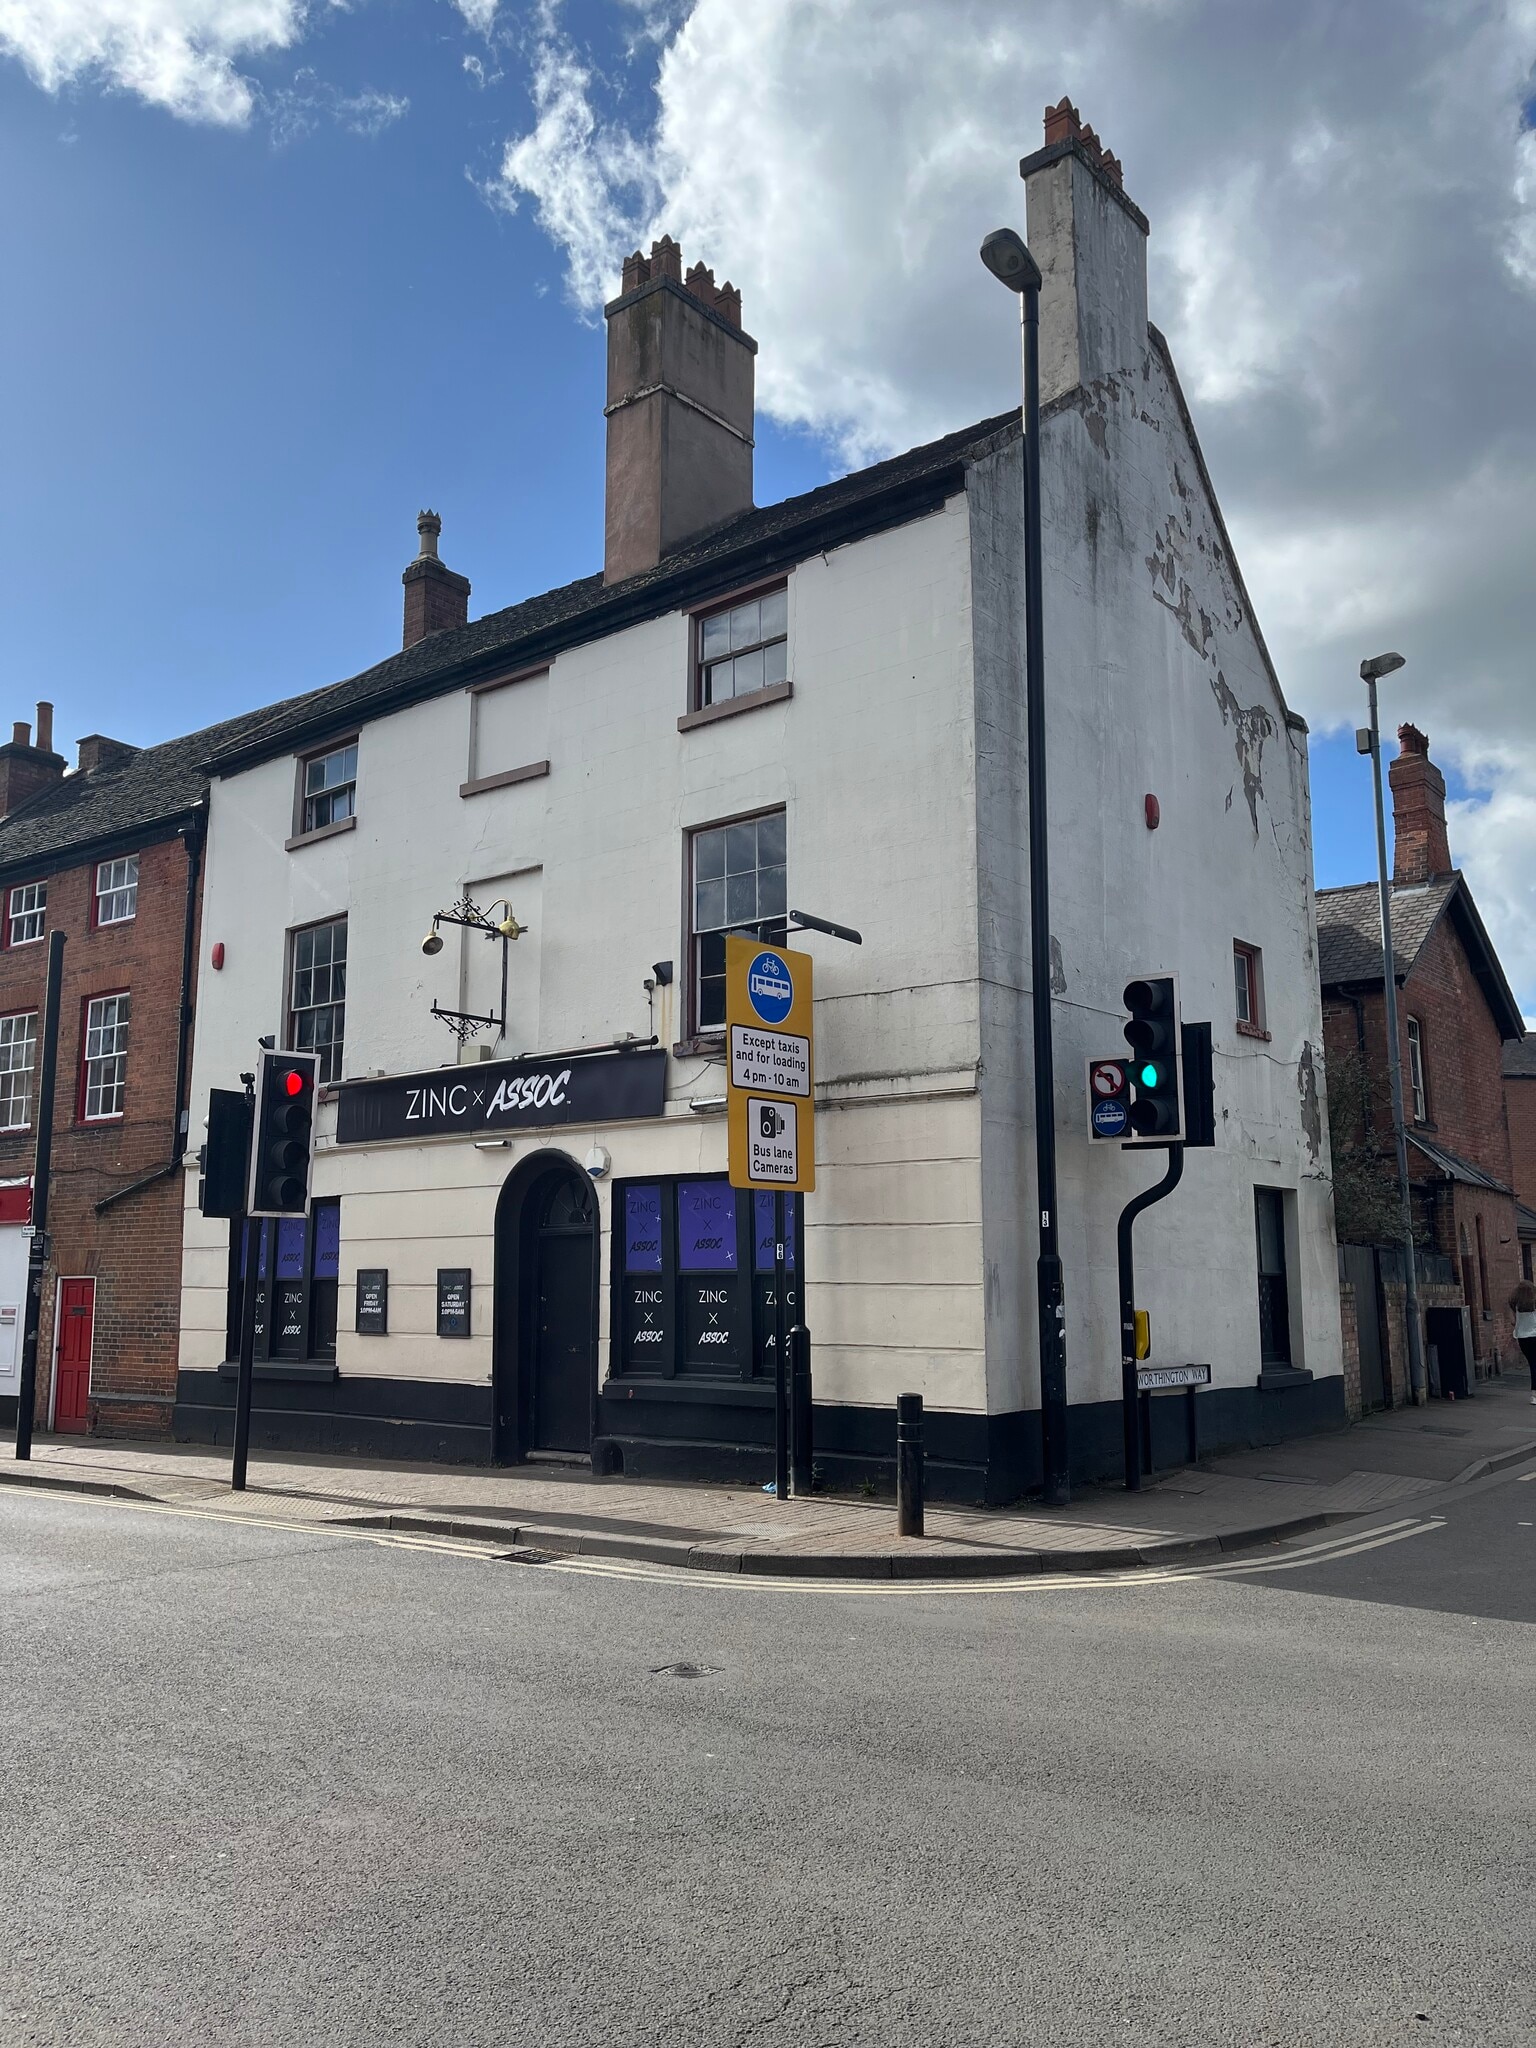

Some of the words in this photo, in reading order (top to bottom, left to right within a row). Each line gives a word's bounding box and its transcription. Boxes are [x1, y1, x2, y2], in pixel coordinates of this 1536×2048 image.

[743, 1033, 776, 1051] Except
[778, 1038, 800, 1054] taxis
[736, 1050, 753, 1062] and
[757, 1052, 770, 1064] for
[773, 1054, 805, 1072] loading
[743, 1068, 750, 1080] 4
[752, 1072, 766, 1083] pm
[774, 1073, 784, 1085] 10
[786, 1077, 799, 1088] am
[406, 1084, 467, 1119] ZINC
[486, 1069, 572, 1119] ASSOC
[754, 1144, 770, 1157] Bus
[774, 1146, 793, 1159] lane
[753, 1160, 794, 1174] Cameras
[630, 1200, 656, 1214] ZINC
[693, 1197, 721, 1210] ZINC
[629, 1240, 658, 1253] ASSOC
[693, 1238, 723, 1250] ASSOC
[284, 1293, 302, 1303] ZINC
[634, 1290, 662, 1303] ZINC
[699, 1290, 728, 1303] ZINC
[282, 1325, 301, 1335] ASSOC
[634, 1330, 664, 1343] ASSOC
[698, 1332, 729, 1344] ASSOC
[1192, 1368, 1206, 1380] WAY
